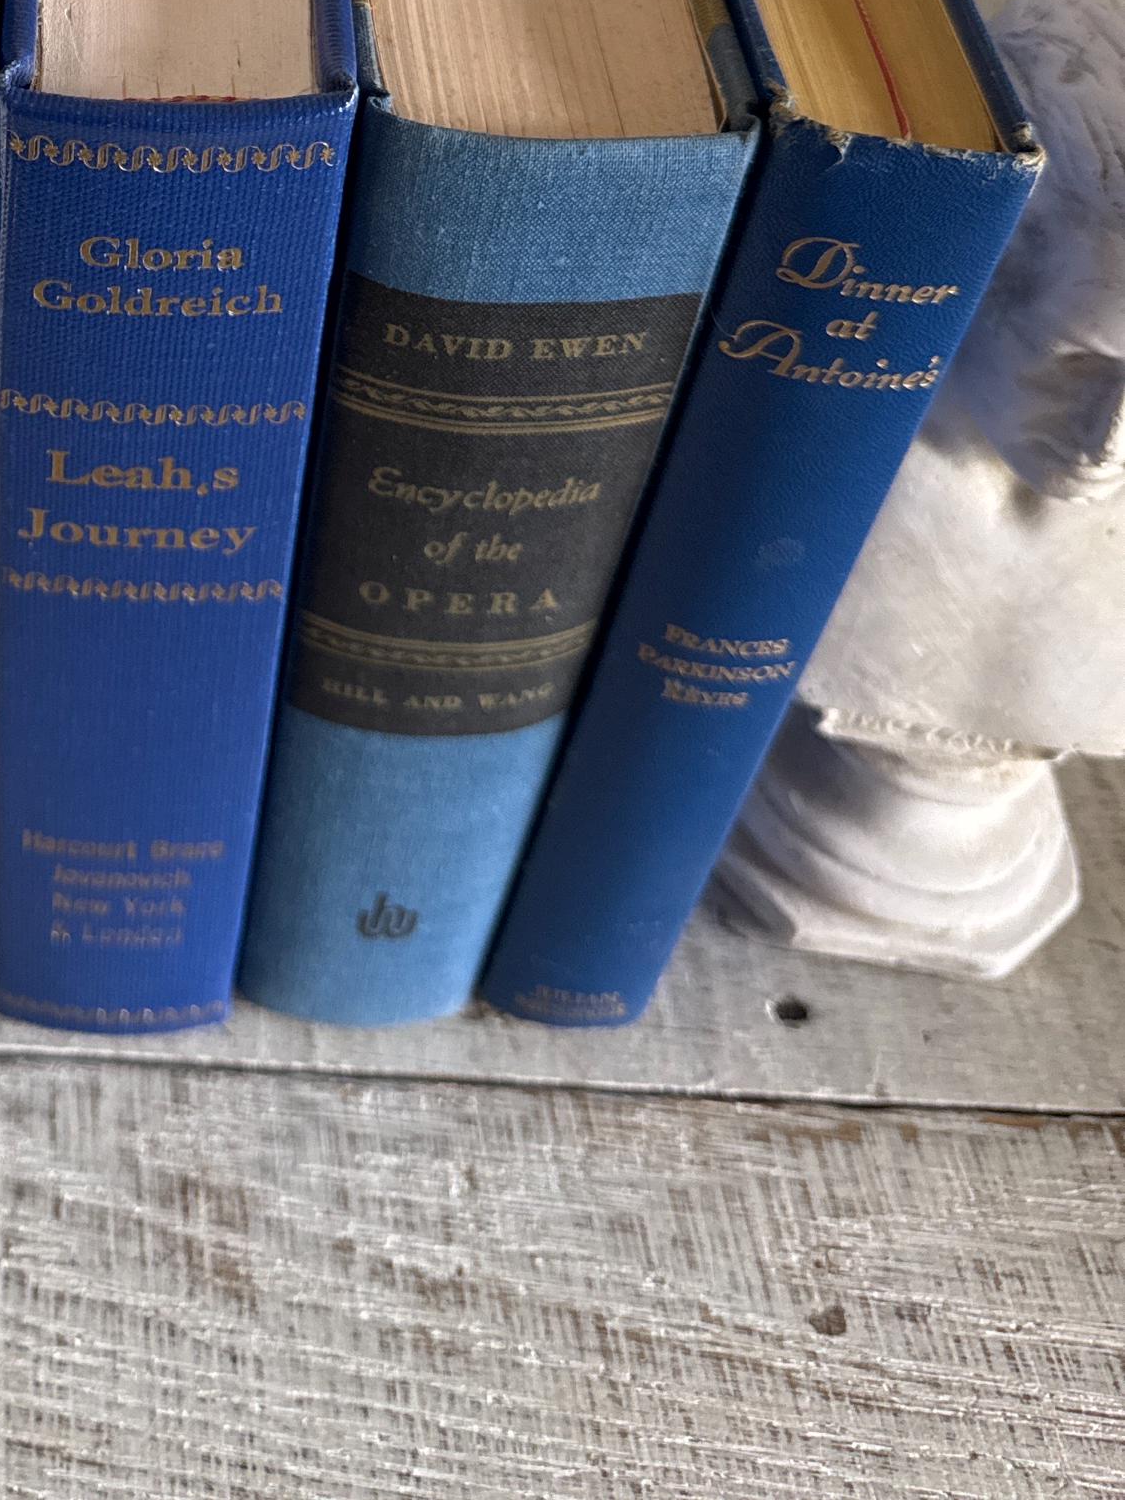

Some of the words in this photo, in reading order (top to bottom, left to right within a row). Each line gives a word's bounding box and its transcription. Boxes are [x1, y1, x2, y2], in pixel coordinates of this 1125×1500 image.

[79, 236, 245, 272] Gloria
[775, 236, 960, 305] Dinner
[32, 278, 284, 316] Goldreich
[383, 322, 513, 361] DAVID
[530, 330, 648, 361] EWEN
[825, 310, 879, 341] at
[717, 319, 943, 392] Antoine's
[367, 465, 603, 517] Encyclopedia
[17, 507, 257, 556] Journey
[423, 530, 471, 565] of
[475, 532, 524, 563] the
[357, 580, 561, 616] OPERA
[664, 622, 791, 657] FRANCES
[637, 641, 796, 683] PARKINSON
[322, 677, 388, 706] HILL
[403, 694, 463, 710] AND
[478, 681, 556, 710] WANG
